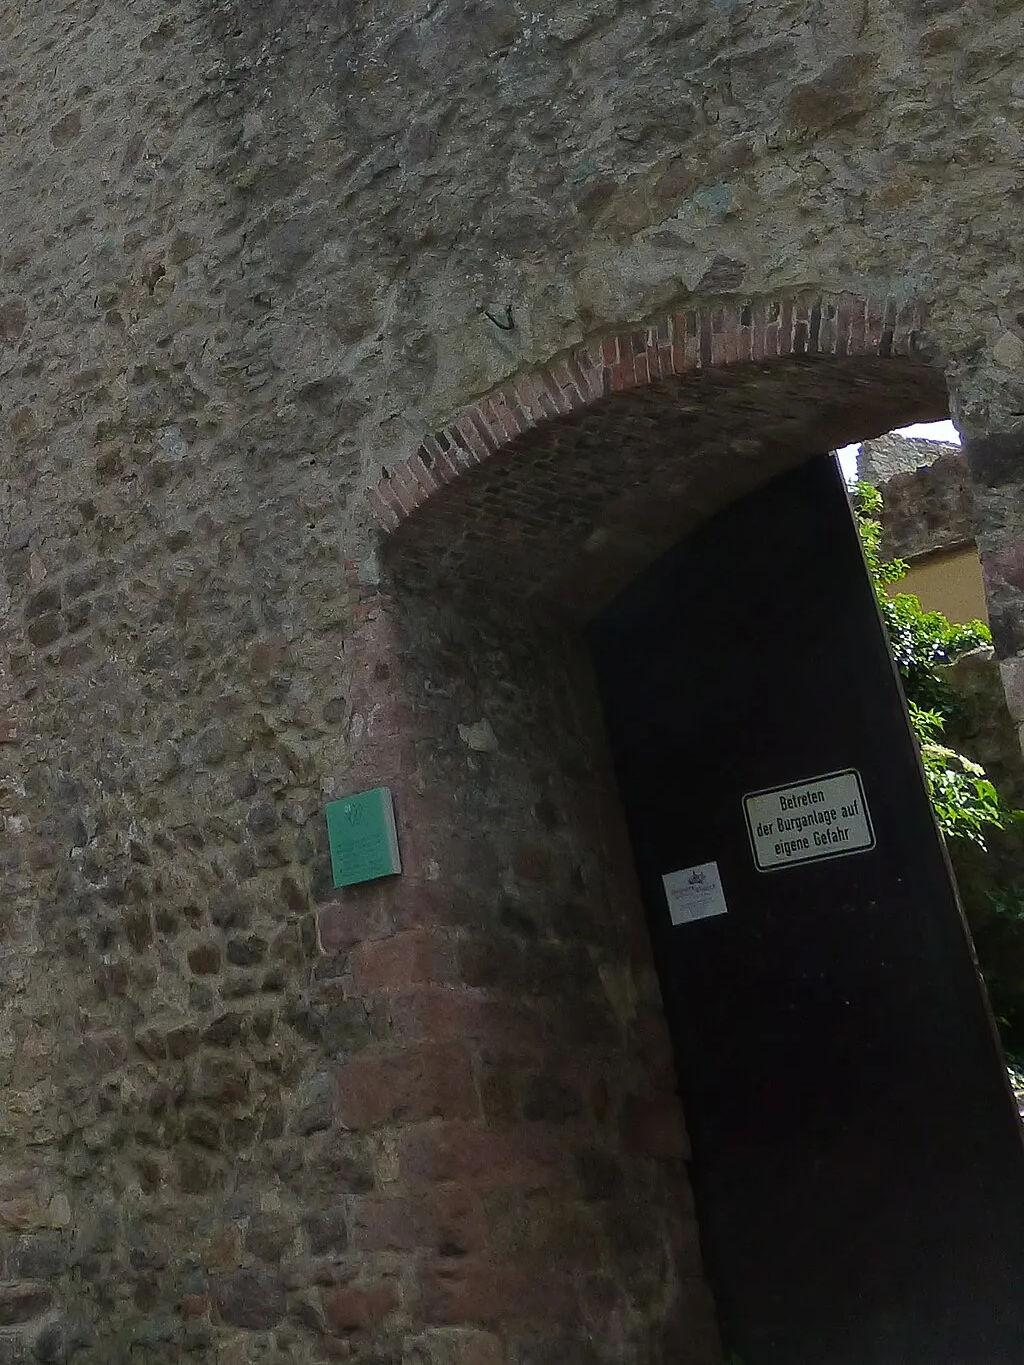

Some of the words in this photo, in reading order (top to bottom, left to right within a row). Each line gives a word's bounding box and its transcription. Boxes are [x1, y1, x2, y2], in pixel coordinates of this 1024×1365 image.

[779, 790, 825, 811] Betreten
[756, 822, 774, 838] der
[776, 809, 837, 832] Burganlage
[841, 800, 859, 818] auf
[774, 838, 809, 857] eigene
[813, 826, 850, 846] Gefahr
